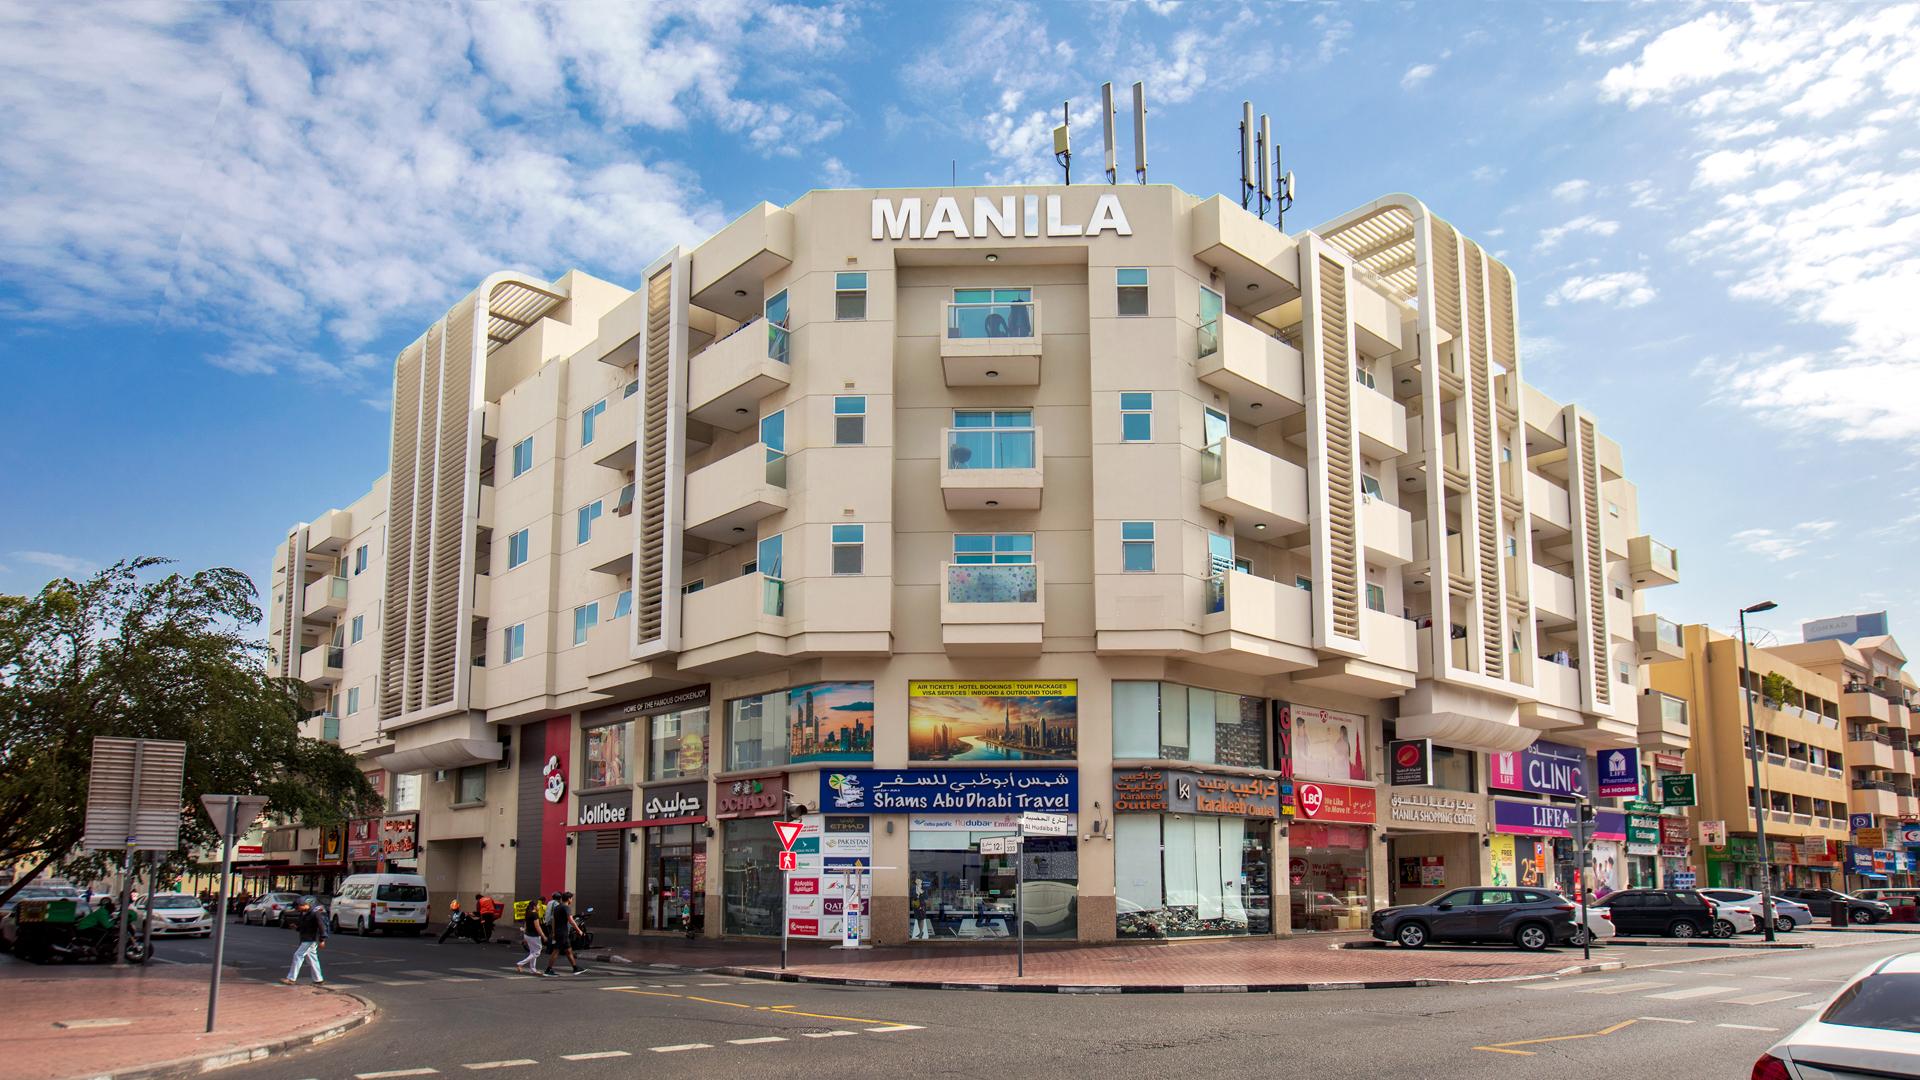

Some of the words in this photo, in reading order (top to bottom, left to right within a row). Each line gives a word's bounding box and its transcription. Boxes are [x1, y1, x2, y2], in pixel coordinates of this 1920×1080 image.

[871, 194, 1133, 240] MANILA
[624, 704, 637, 713] HOME
[637, 702, 644, 711] OF
[644, 701, 654, 710] THE
[654, 696, 674, 708] FAMOUS
[674, 690, 707, 703] CHICKENJOY
[1280, 707, 1293, 779] GYM
[873, 773, 947, 789] للسفر
[950, 772, 1014, 793] أبوظبي
[1018, 773, 1069, 788] شمس
[1120, 771, 1162, 782] كراكيب
[1500, 774, 1514, 785] LIFE
[1529, 759, 1582, 792] CLINIC
[1120, 792, 1162, 801] Karakeeb
[1231, 779, 1277, 800] كراكيب
[646, 792, 701, 818] جوليبي
[720, 793, 776, 811] OCHADO
[873, 792, 927, 808] Shams
[1015, 793, 1069, 808] Travel
[1115, 800, 1168, 810] Outlet
[1197, 794, 1247, 814] Karakeeb
[1248, 803, 1275, 817] Outlet
[1303, 793, 1320, 805] LBC
[1391, 793, 1428, 807] للتسوق
[1429, 796, 1455, 809] مانيلا
[1455, 799, 1476, 812] مركز
[580, 802, 626, 824] Jollibee
[1331, 806, 1345, 814] Move
[1392, 808, 1419, 821] MANILA
[1420, 811, 1453, 823] SHOPPING
[1453, 813, 1476, 825] CENTRE
[1532, 806, 1562, 828] LIFE
[825, 902, 843, 910] QAT
